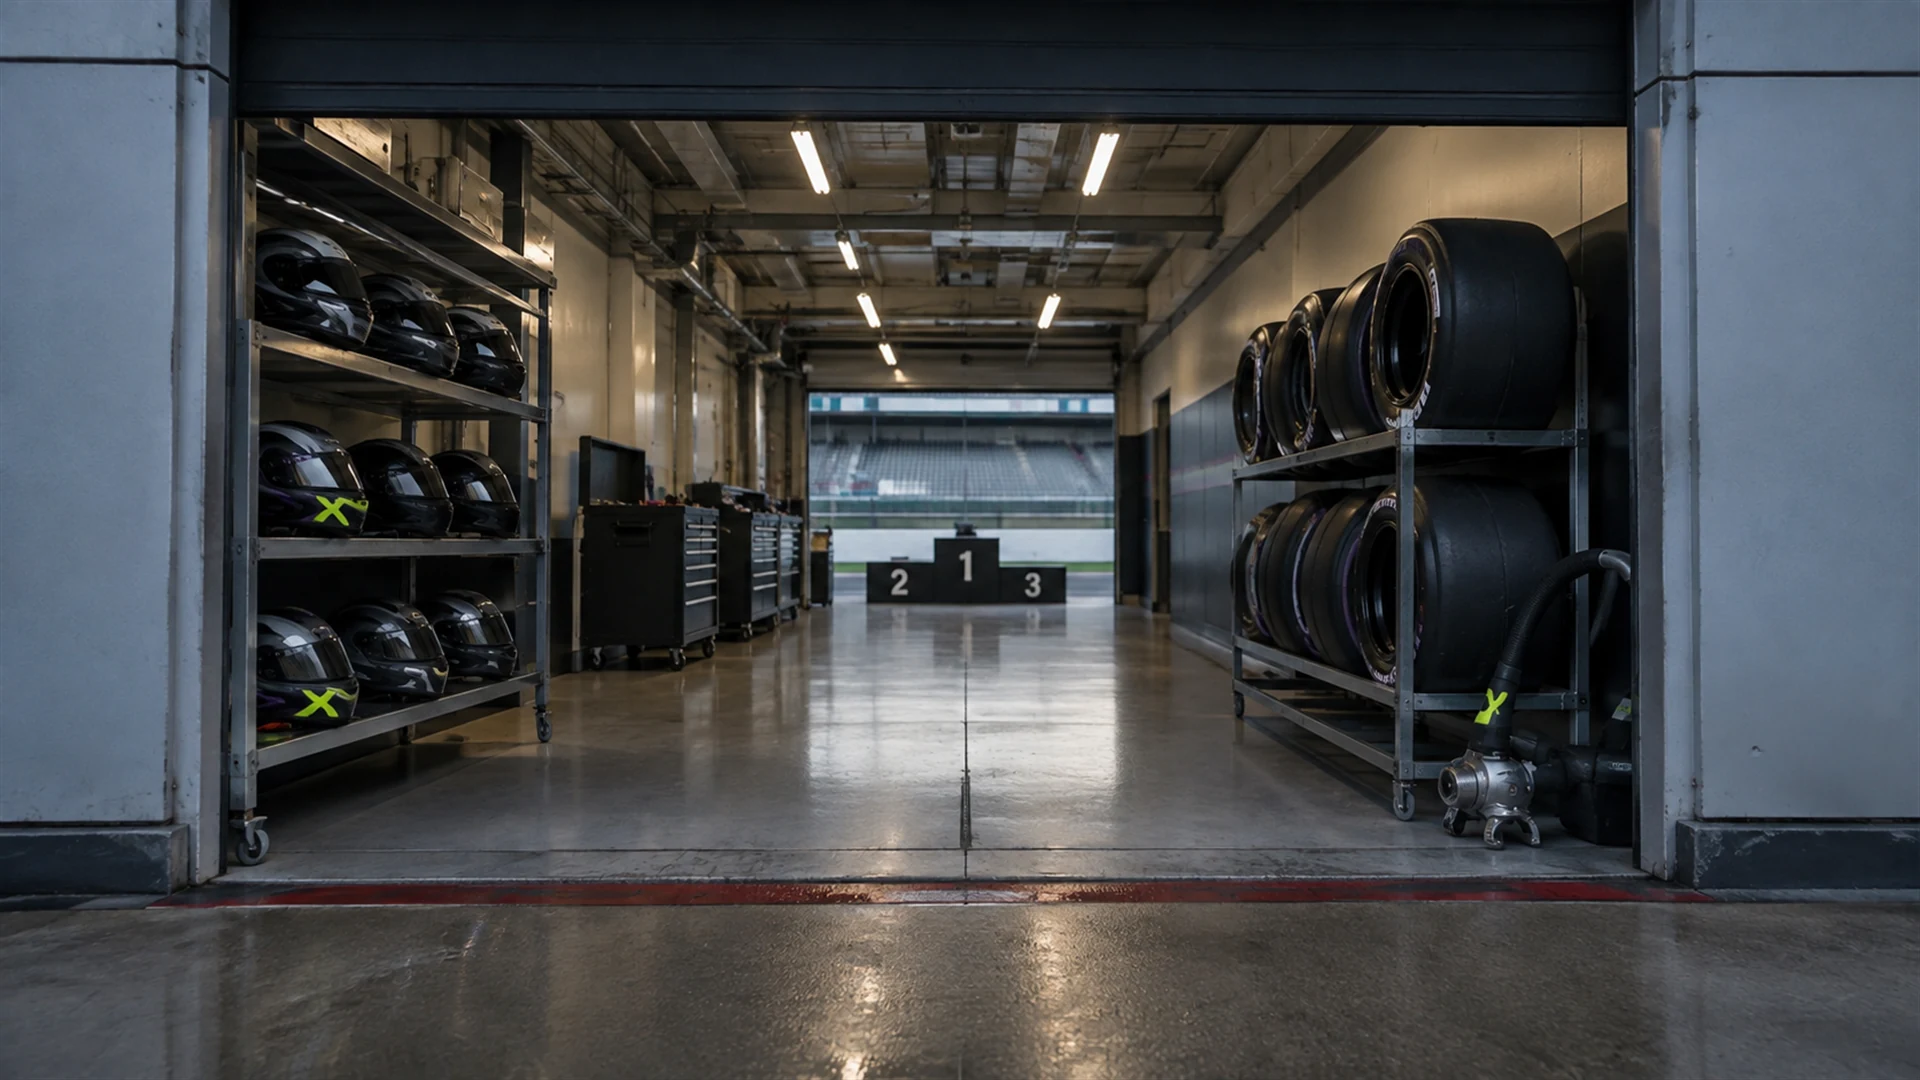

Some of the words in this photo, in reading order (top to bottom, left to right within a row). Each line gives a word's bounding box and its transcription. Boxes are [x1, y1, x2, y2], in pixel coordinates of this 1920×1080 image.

[959, 550, 973, 582] 1
[890, 568, 909, 596] 2
[1024, 572, 1041, 598] 3
